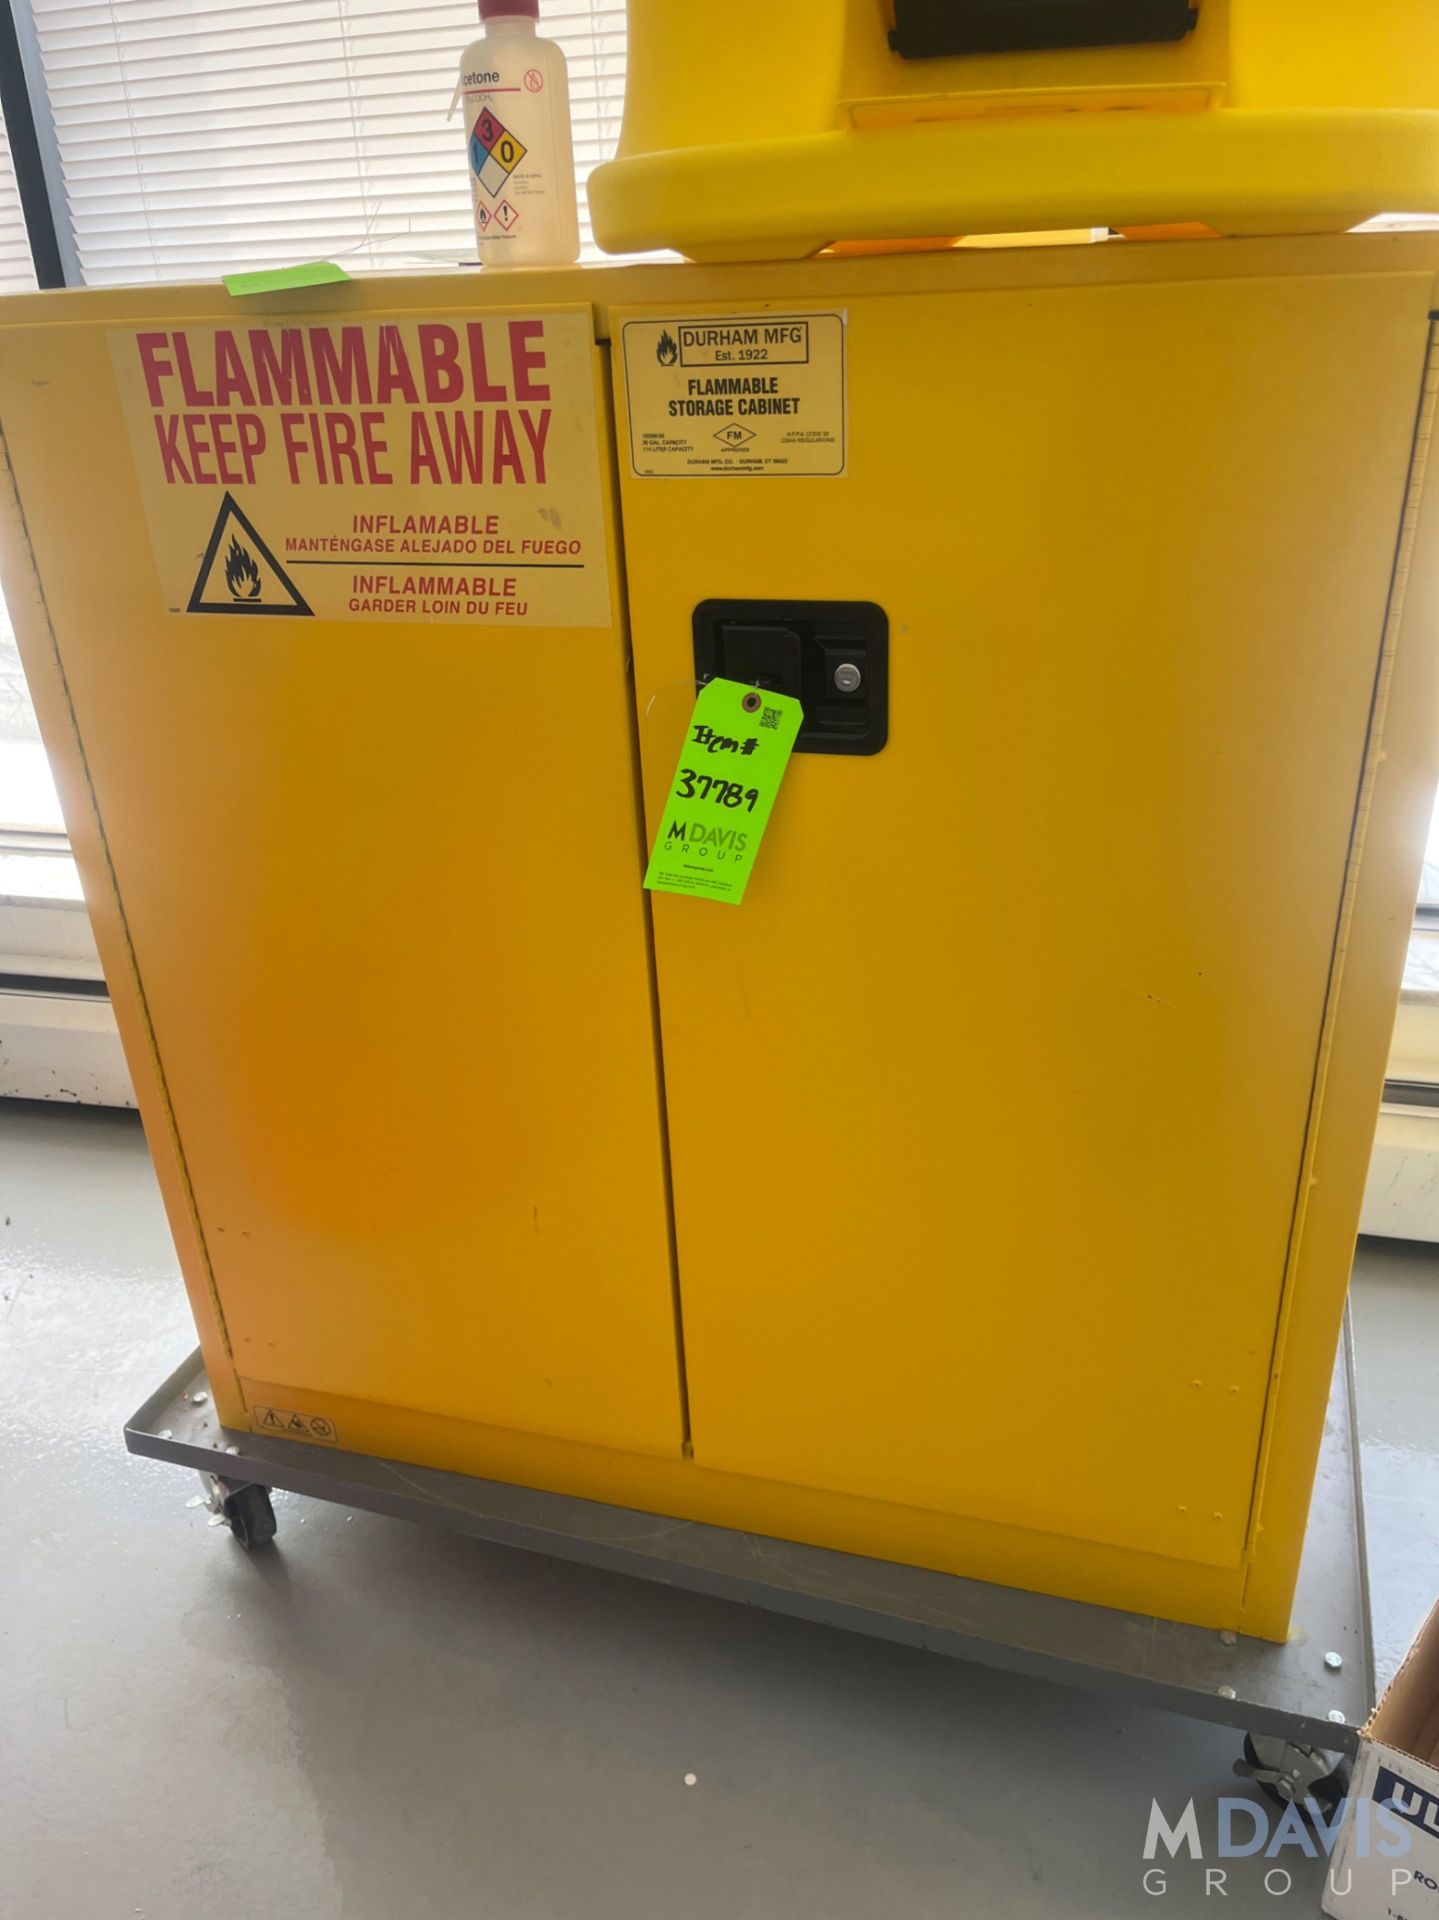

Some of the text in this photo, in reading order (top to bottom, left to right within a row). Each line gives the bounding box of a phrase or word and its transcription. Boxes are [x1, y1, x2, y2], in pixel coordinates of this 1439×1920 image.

[462, 71, 500, 86] cetone
[482, 118, 494, 142] 3
[500, 141, 514, 163] 0
[683, 326, 802, 347] DURHAM MFG
[136, 320, 551, 407] FLAMMABLE
[715, 349, 768, 361] Est. 1922
[688, 377, 778, 396] FLAMMABLE
[669, 398, 800, 417] STORAGE CABINET
[727, 431, 742, 440] FM
[154, 409, 552, 485] KEEP FIRE AWAY
[352, 515, 499, 535] INFLAMABLE
[285, 534, 581, 555] MANTÉNGASE ALEJADO DEL FUEGO
[352, 575, 517, 596] INFLAMMABLE
[348, 598, 528, 616] GARDER LOIN DU FEU
[675, 768, 759, 813] 37789
[664, 841, 743, 864] GROUP
[1413, 1870, 1439, 1893] RO
